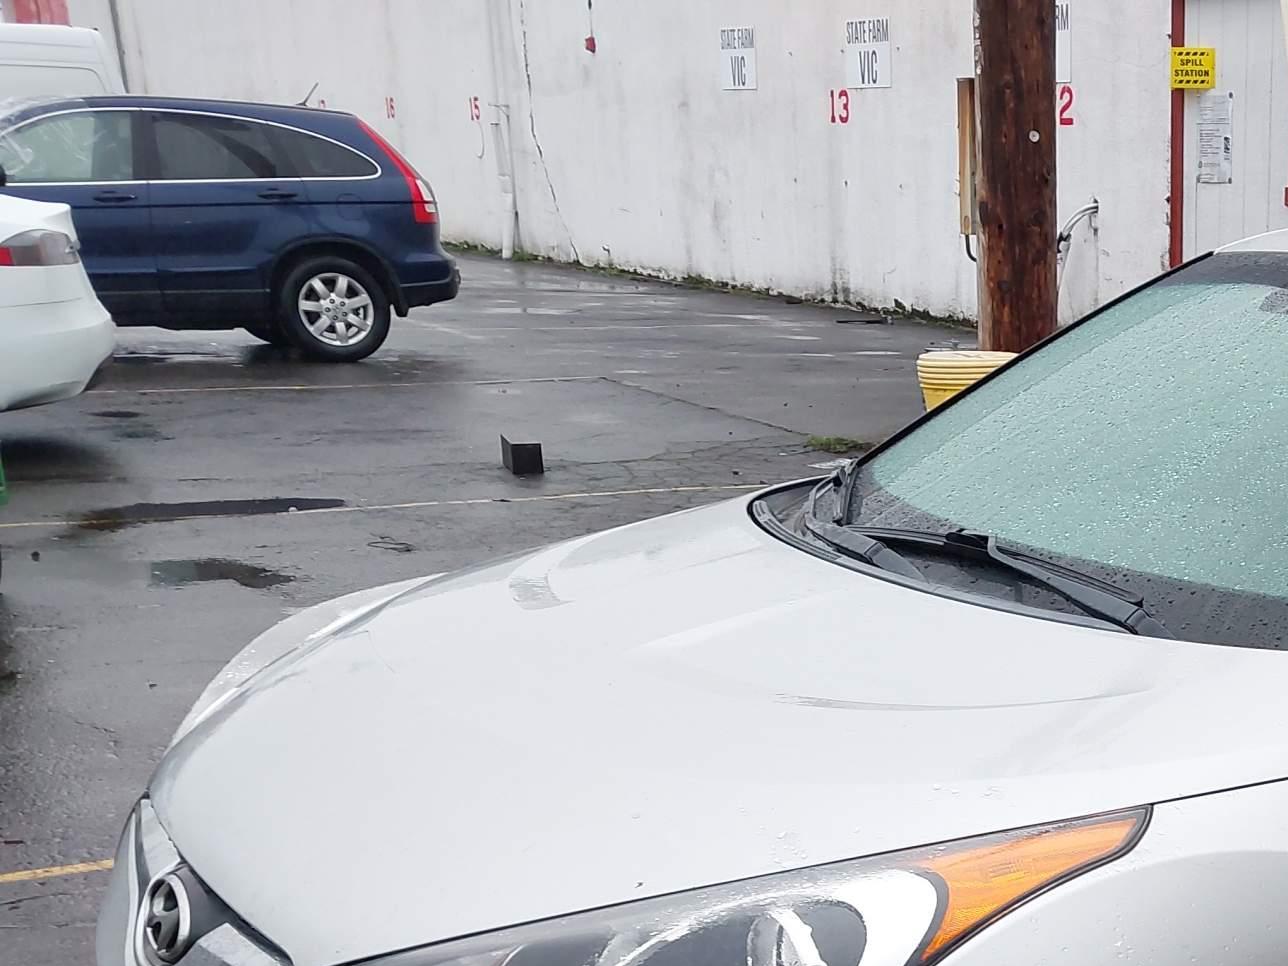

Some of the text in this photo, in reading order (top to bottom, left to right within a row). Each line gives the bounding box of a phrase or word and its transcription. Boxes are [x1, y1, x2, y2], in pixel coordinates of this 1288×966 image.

[720, 28, 754, 50] STATE FARM
[846, 18, 889, 44] STATE FARM
[730, 56, 746, 87] VIC
[858, 50, 878, 84] VIC
[1174, 69, 1210, 77] STATION
[1180, 58, 1204, 67] SPILL
[469, 96, 481, 121] 15
[829, 89, 849, 123] 13
